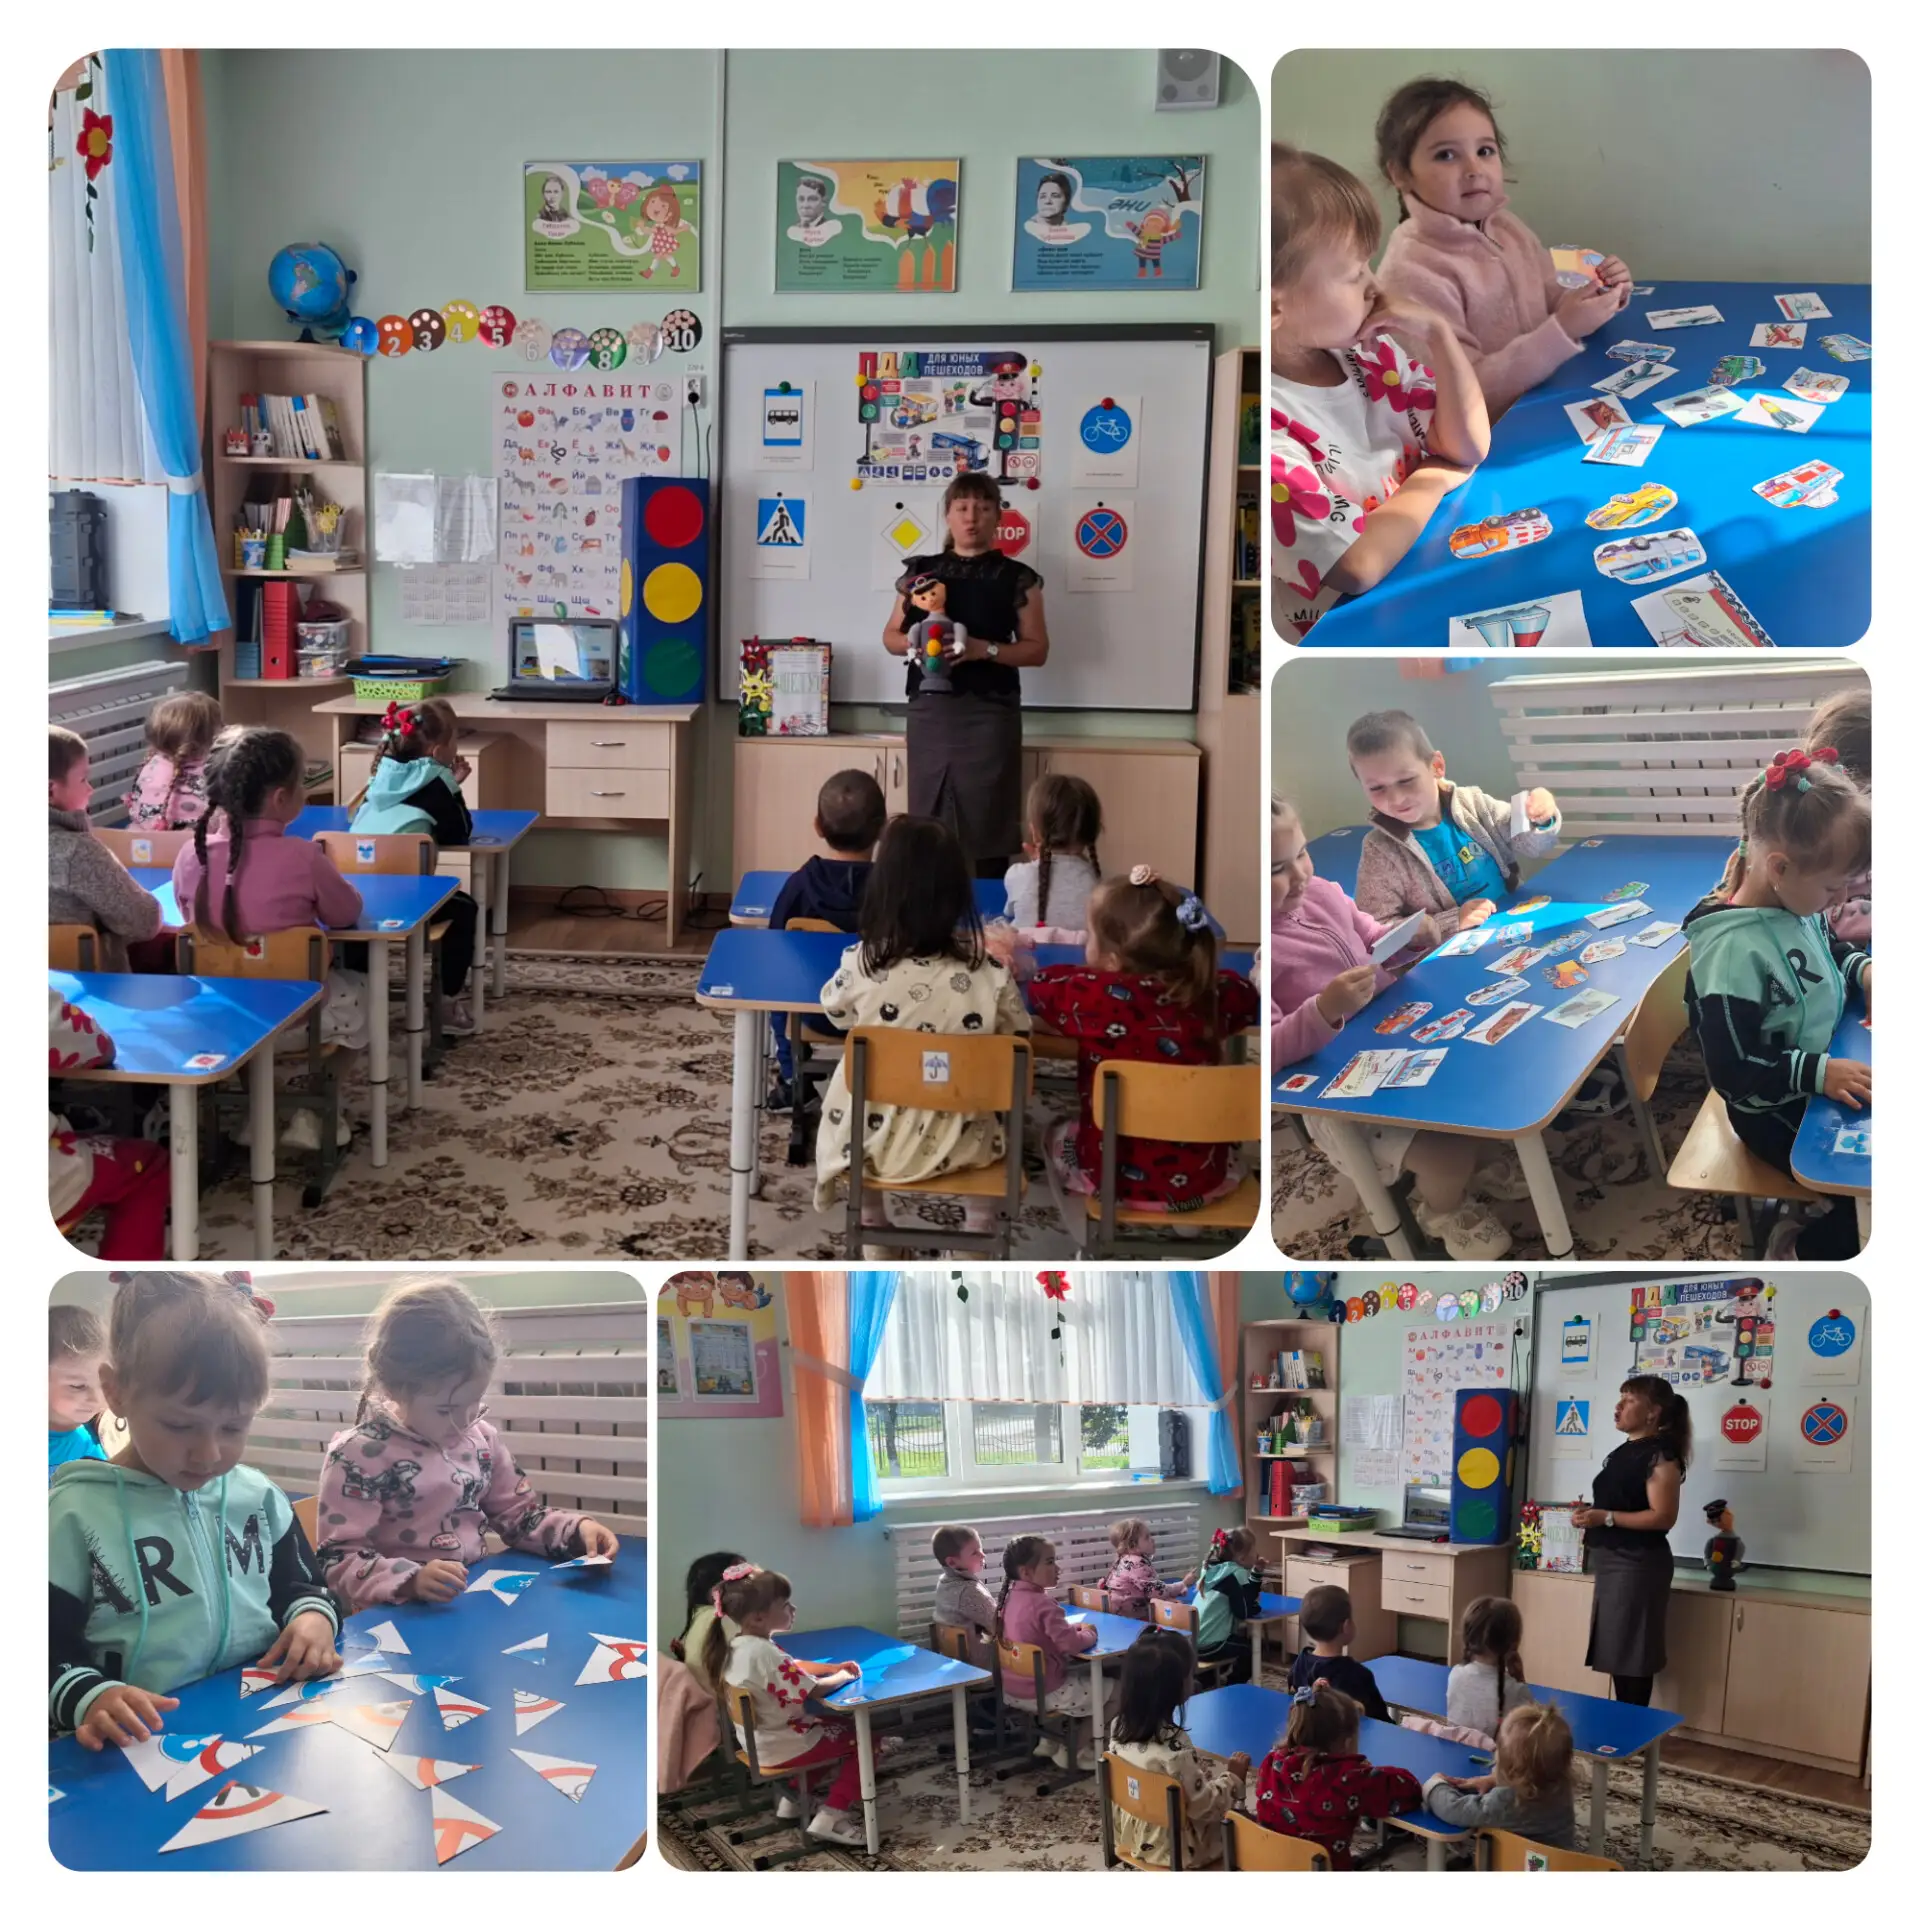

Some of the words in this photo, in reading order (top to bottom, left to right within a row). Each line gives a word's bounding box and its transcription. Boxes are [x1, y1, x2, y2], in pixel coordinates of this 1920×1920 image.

[387, 336, 401, 357] 2
[419, 331, 432, 351] 3
[450, 323, 464, 343] 4
[491, 327, 505, 348] 5
[525, 340, 538, 362] 6
[563, 351, 575, 371] 7
[598, 349, 612, 371] 8
[633, 342, 648, 365] 9
[671, 328, 696, 351] 10
[858, 351, 920, 379] ПДД
[926, 353, 948, 365] ДЛЯ
[949, 353, 980, 364] ЮНЫХ
[923, 364, 984, 376] ПЕШЕХОДОВ
[524, 383, 651, 399] АЛФАВИТ
[572, 406, 586, 416] Бб
[639, 408, 650, 416] Гг
[604, 504, 619, 513] Оо
[991, 526, 1026, 541] TOP
[571, 564, 584, 573] Хх
[1631, 1284, 1677, 1309] ПДД
[1683, 1284, 1698, 1293] ДЛЯ
[1700, 1281, 1725, 1291] ЮНЫХ
[1680, 1290, 1728, 1302] ПЕШЕХОДОВ
[1351, 1310, 1359, 1323] 2
[1366, 1305, 1374, 1318] 3
[1403, 1297, 1411, 1310] 5
[1507, 1284, 1524, 1300] 10
[1420, 1325, 1495, 1341] АЛФАВИТ
[1725, 1418, 1759, 1431] STOP
